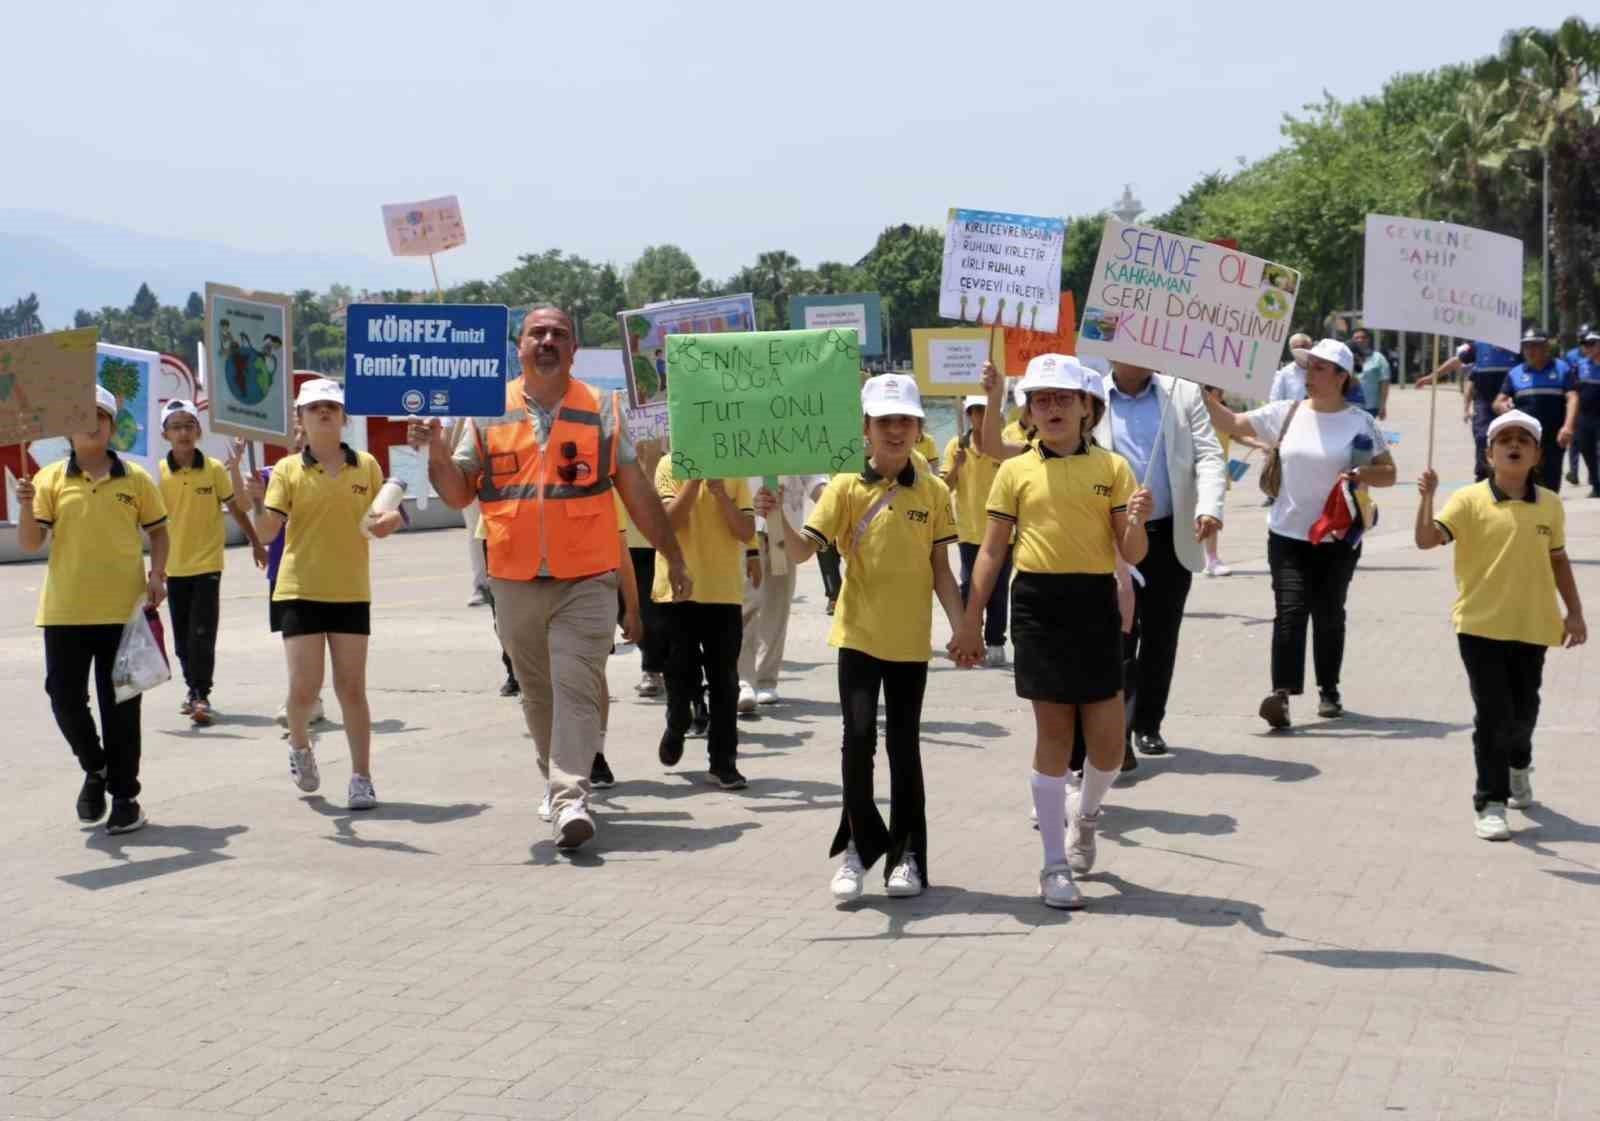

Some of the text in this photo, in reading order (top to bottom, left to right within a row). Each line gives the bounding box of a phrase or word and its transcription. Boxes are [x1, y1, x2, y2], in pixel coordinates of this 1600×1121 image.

[963, 239, 1003, 255] RUHUNU
[1116, 228, 1253, 288] SENDE OL
[988, 261, 1026, 277] RUHLAR
[1104, 260, 1191, 294] KAHRAMAN
[1102, 283, 1153, 311] GERİ
[354, 353, 500, 380] Temiz Tutuyoruz
[692, 400, 745, 424] TUT
[770, 391, 824, 419] ONU
[712, 424, 833, 459] BIRAKMA
